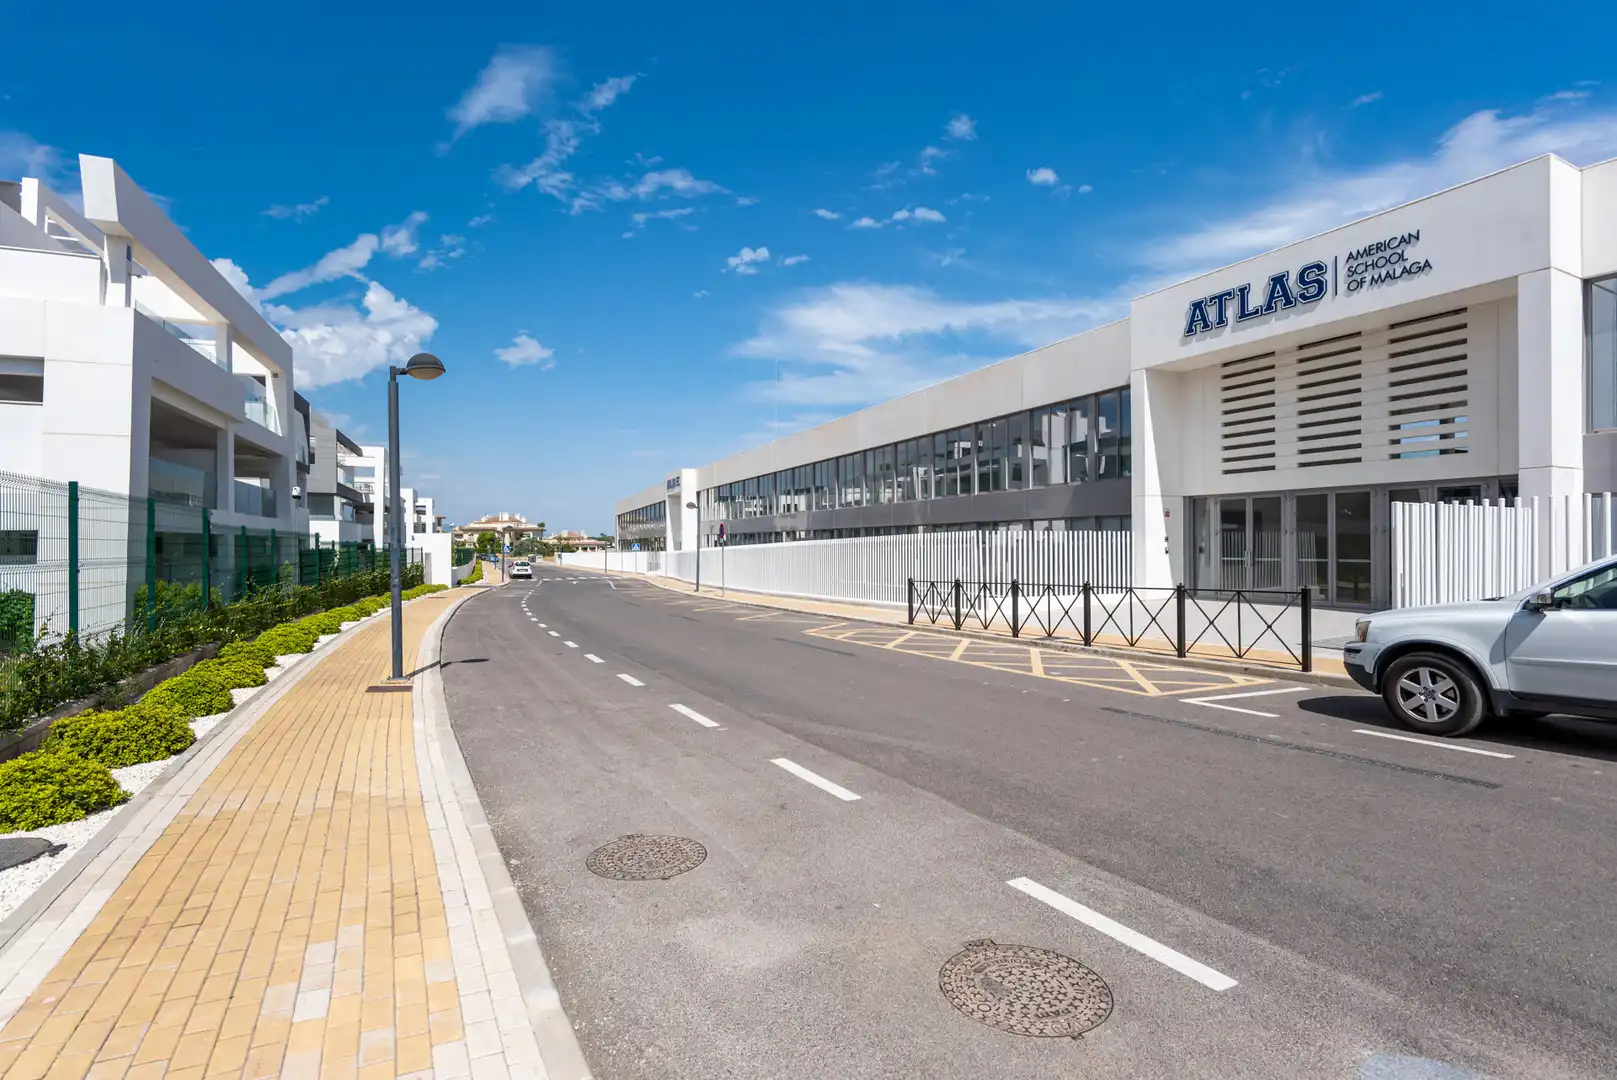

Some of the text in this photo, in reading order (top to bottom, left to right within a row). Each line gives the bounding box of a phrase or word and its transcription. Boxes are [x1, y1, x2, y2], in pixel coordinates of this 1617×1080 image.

[1346, 229, 1419, 263] AMERICAN
[1347, 249, 1408, 277] SCHOOL
[1347, 258, 1432, 291] OF MALAGA
[1184, 260, 1327, 336] ATLAS
